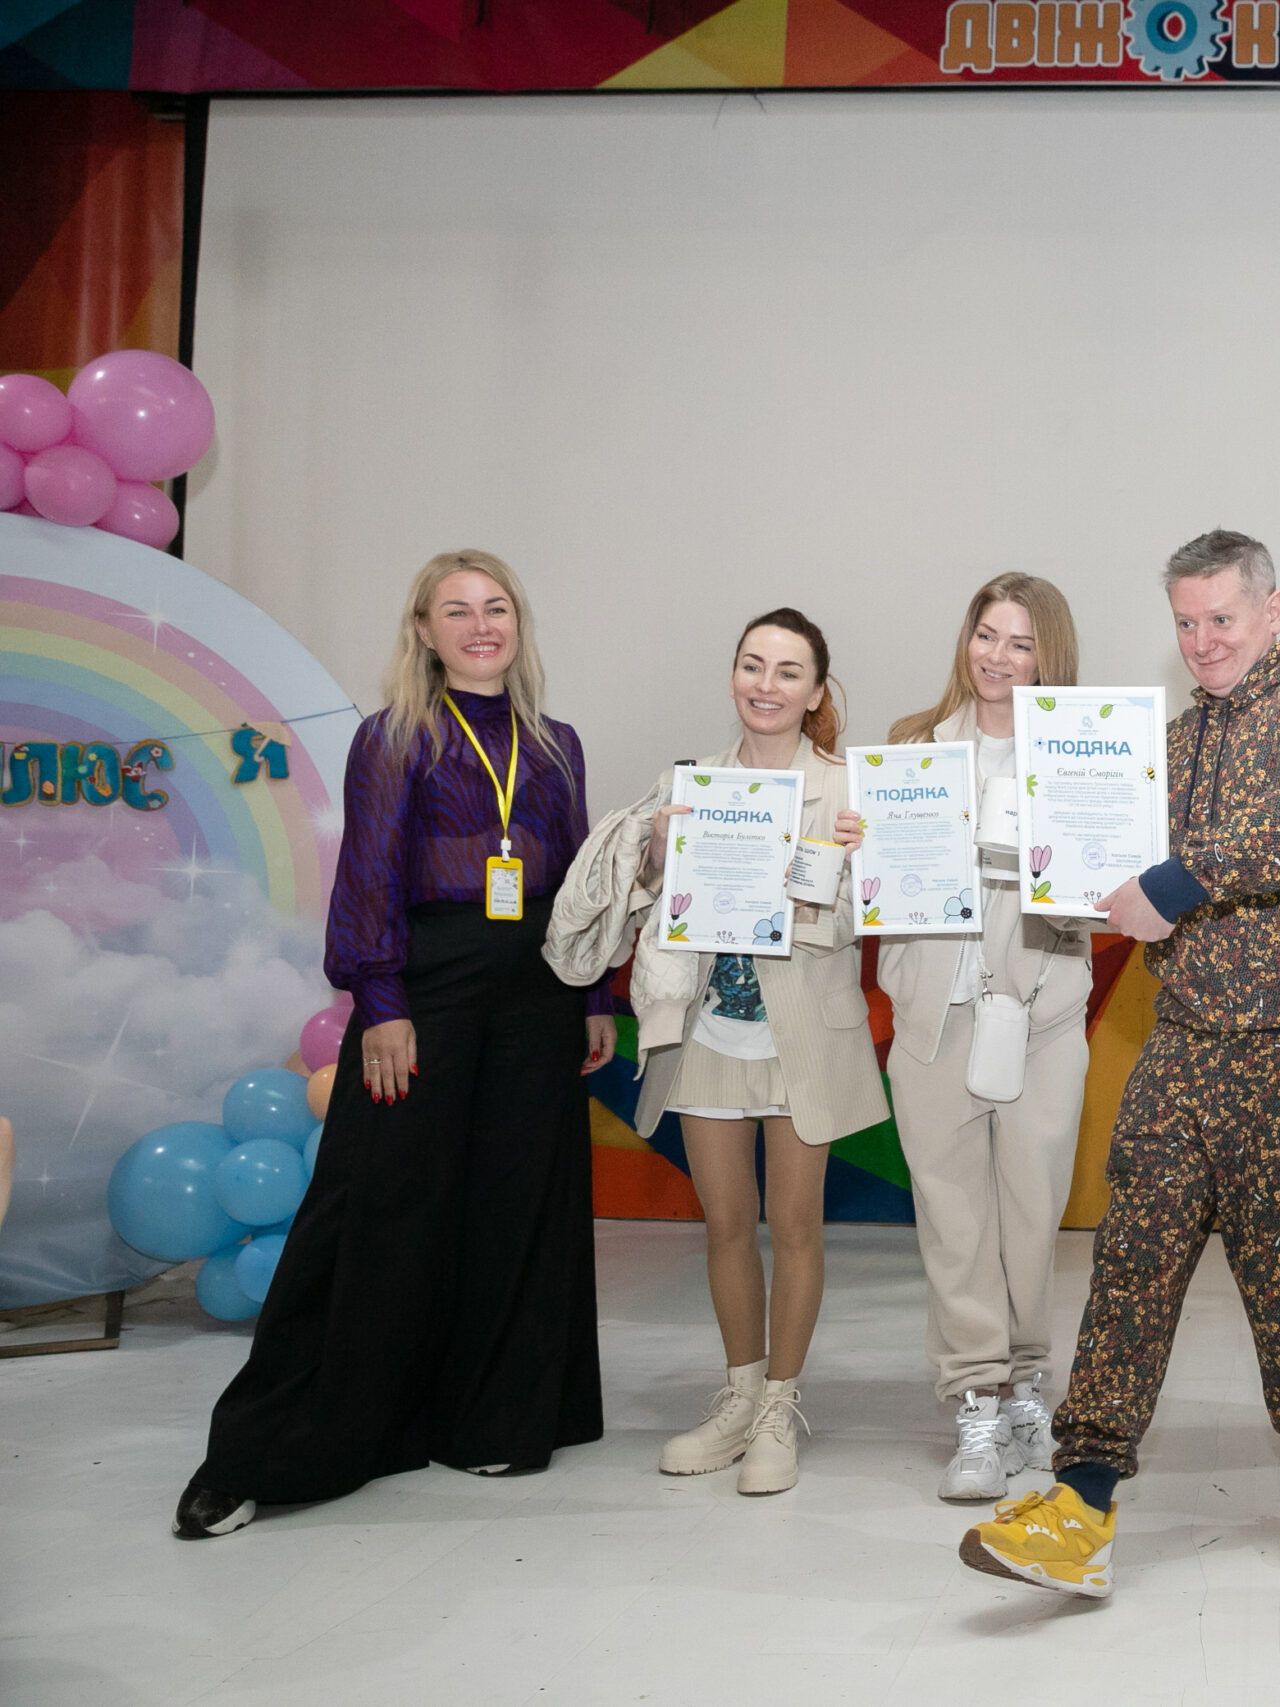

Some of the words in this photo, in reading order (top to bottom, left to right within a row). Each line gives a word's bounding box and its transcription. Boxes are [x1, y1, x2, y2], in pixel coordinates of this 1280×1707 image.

[1048, 739, 1132, 757] ПОДЯКА
[0, 739, 176, 811] ЛЮС
[876, 786, 949, 803] ПОДЯКА
[699, 808, 774, 824] ПОДЯКА
[965, 1405, 979, 1414] FILA
